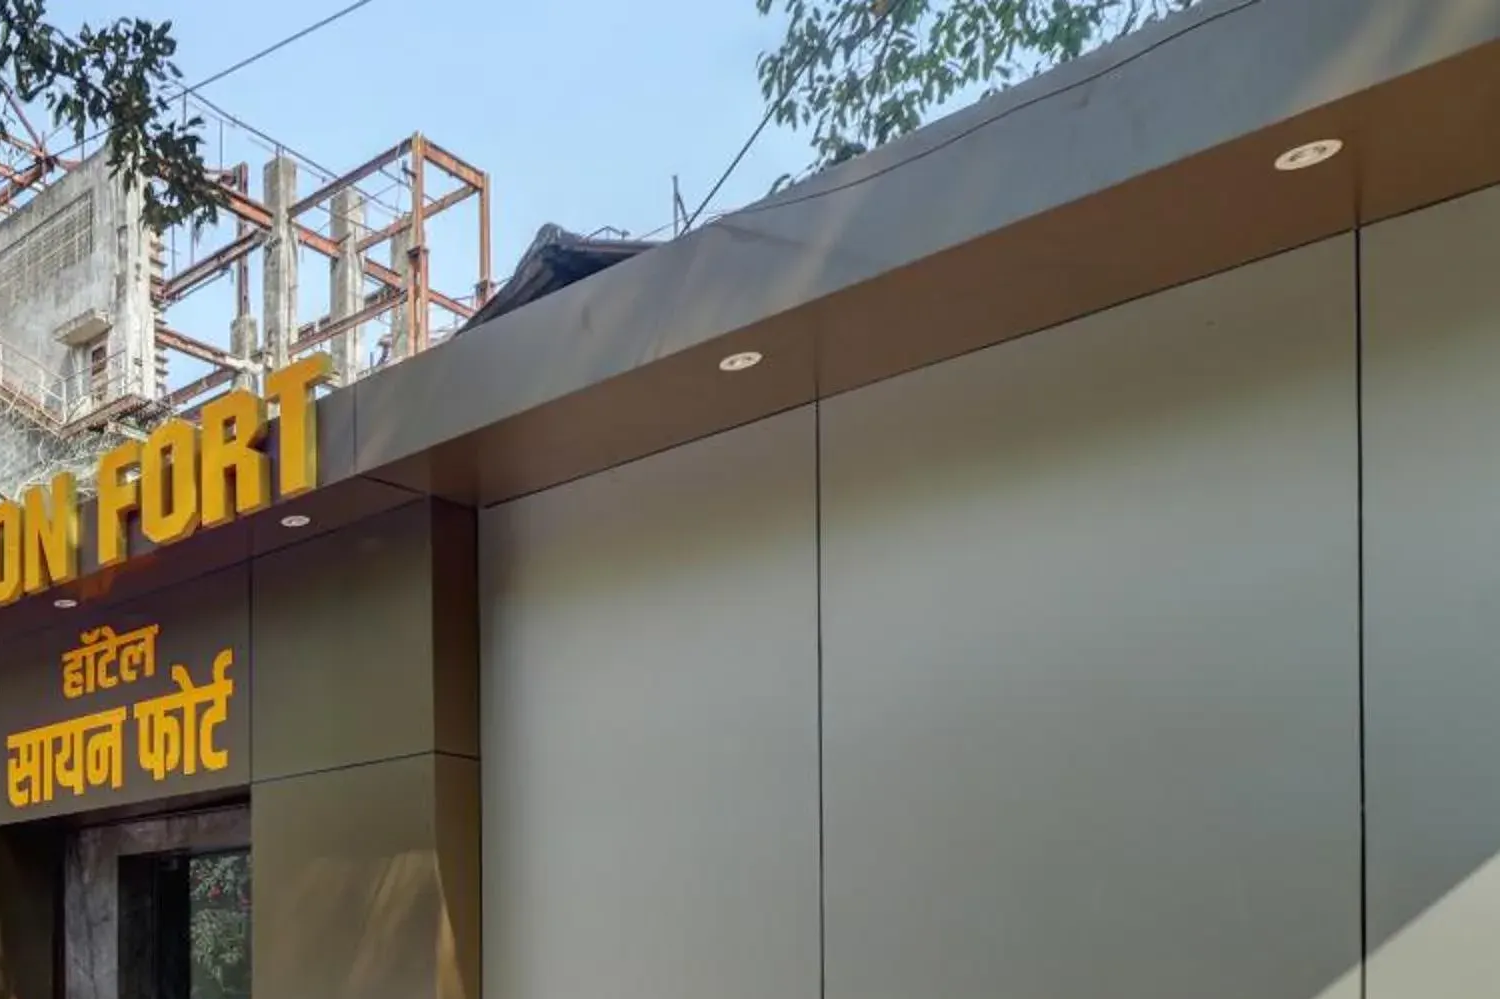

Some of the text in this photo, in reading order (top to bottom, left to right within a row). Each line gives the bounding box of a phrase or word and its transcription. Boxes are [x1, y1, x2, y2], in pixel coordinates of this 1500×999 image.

[98, 352, 332, 566] FORT
[7, 648, 233, 808] सायन फोर्ट
[61, 623, 159, 699] हॉटेल
